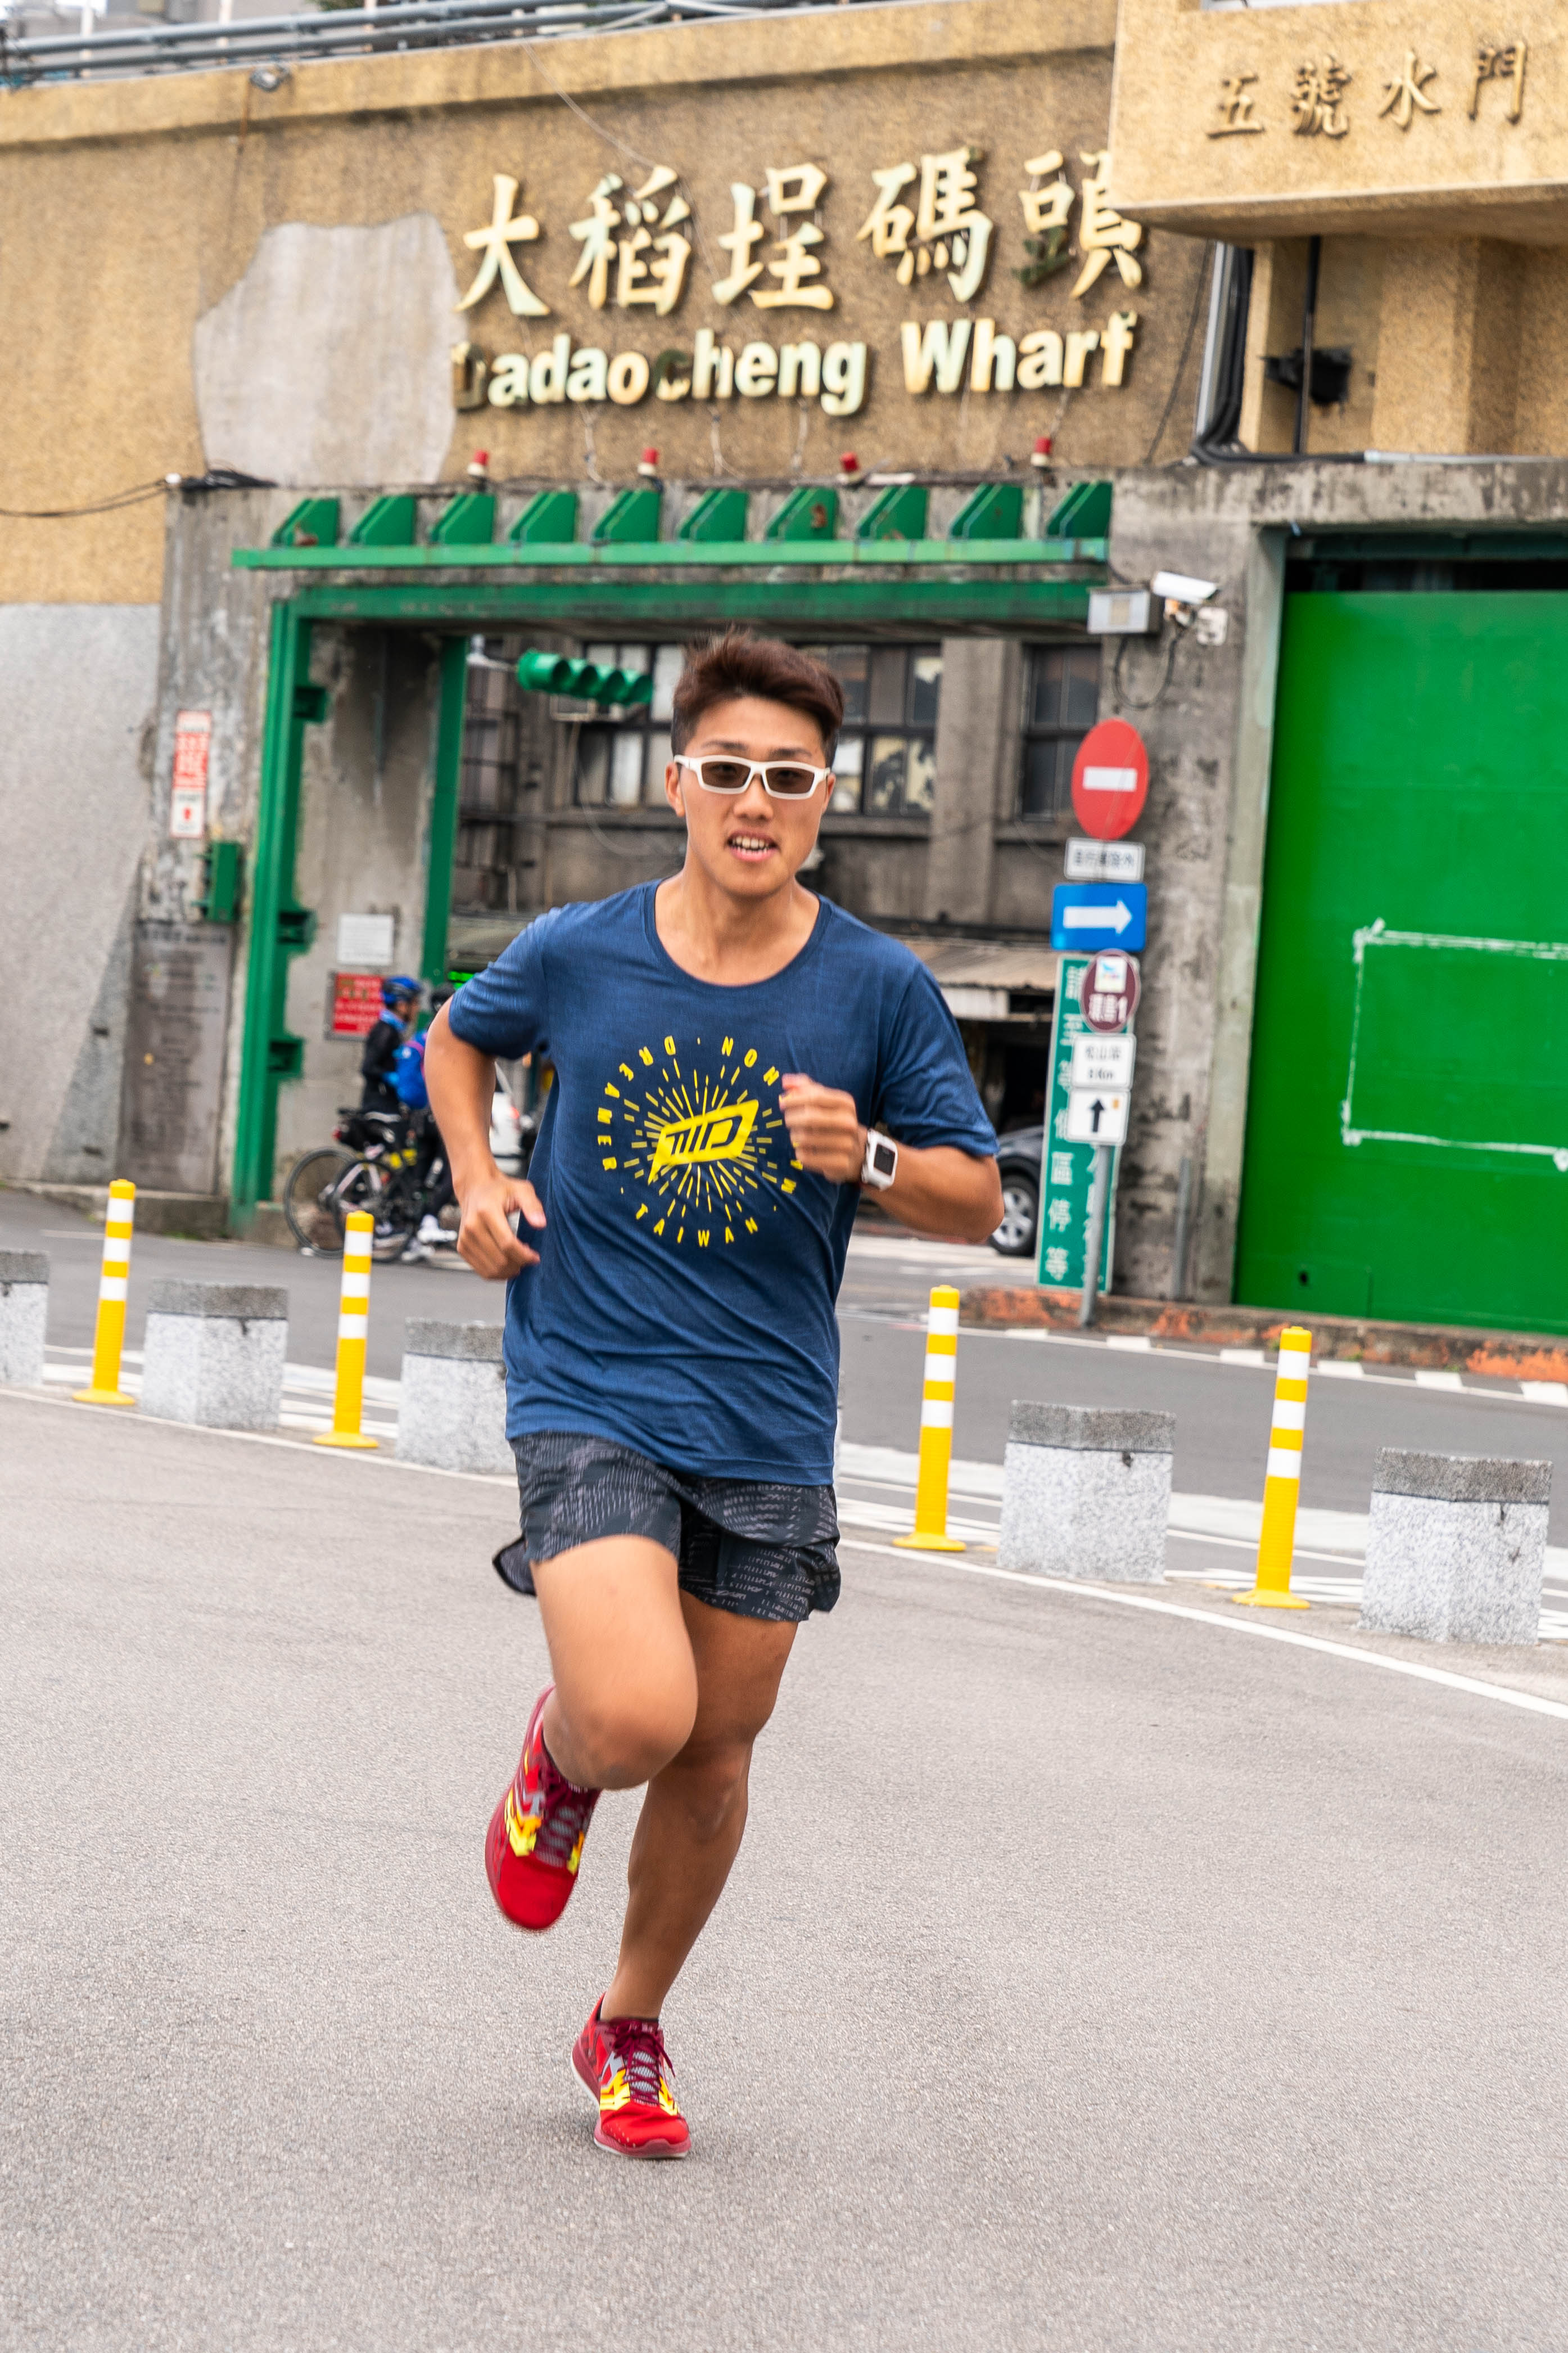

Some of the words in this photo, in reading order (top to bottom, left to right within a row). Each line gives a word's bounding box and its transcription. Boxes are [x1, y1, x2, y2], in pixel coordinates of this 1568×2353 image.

[1206, 39, 1528, 139] 五號水門
[453, 146, 1143, 317] 大稻埕碼頭
[451, 327, 869, 416] Dadaocheng
[900, 310, 1138, 395] Wharf
[597, 1035, 676, 1171] DREAMER
[636, 1202, 758, 1247] TAIWAN
